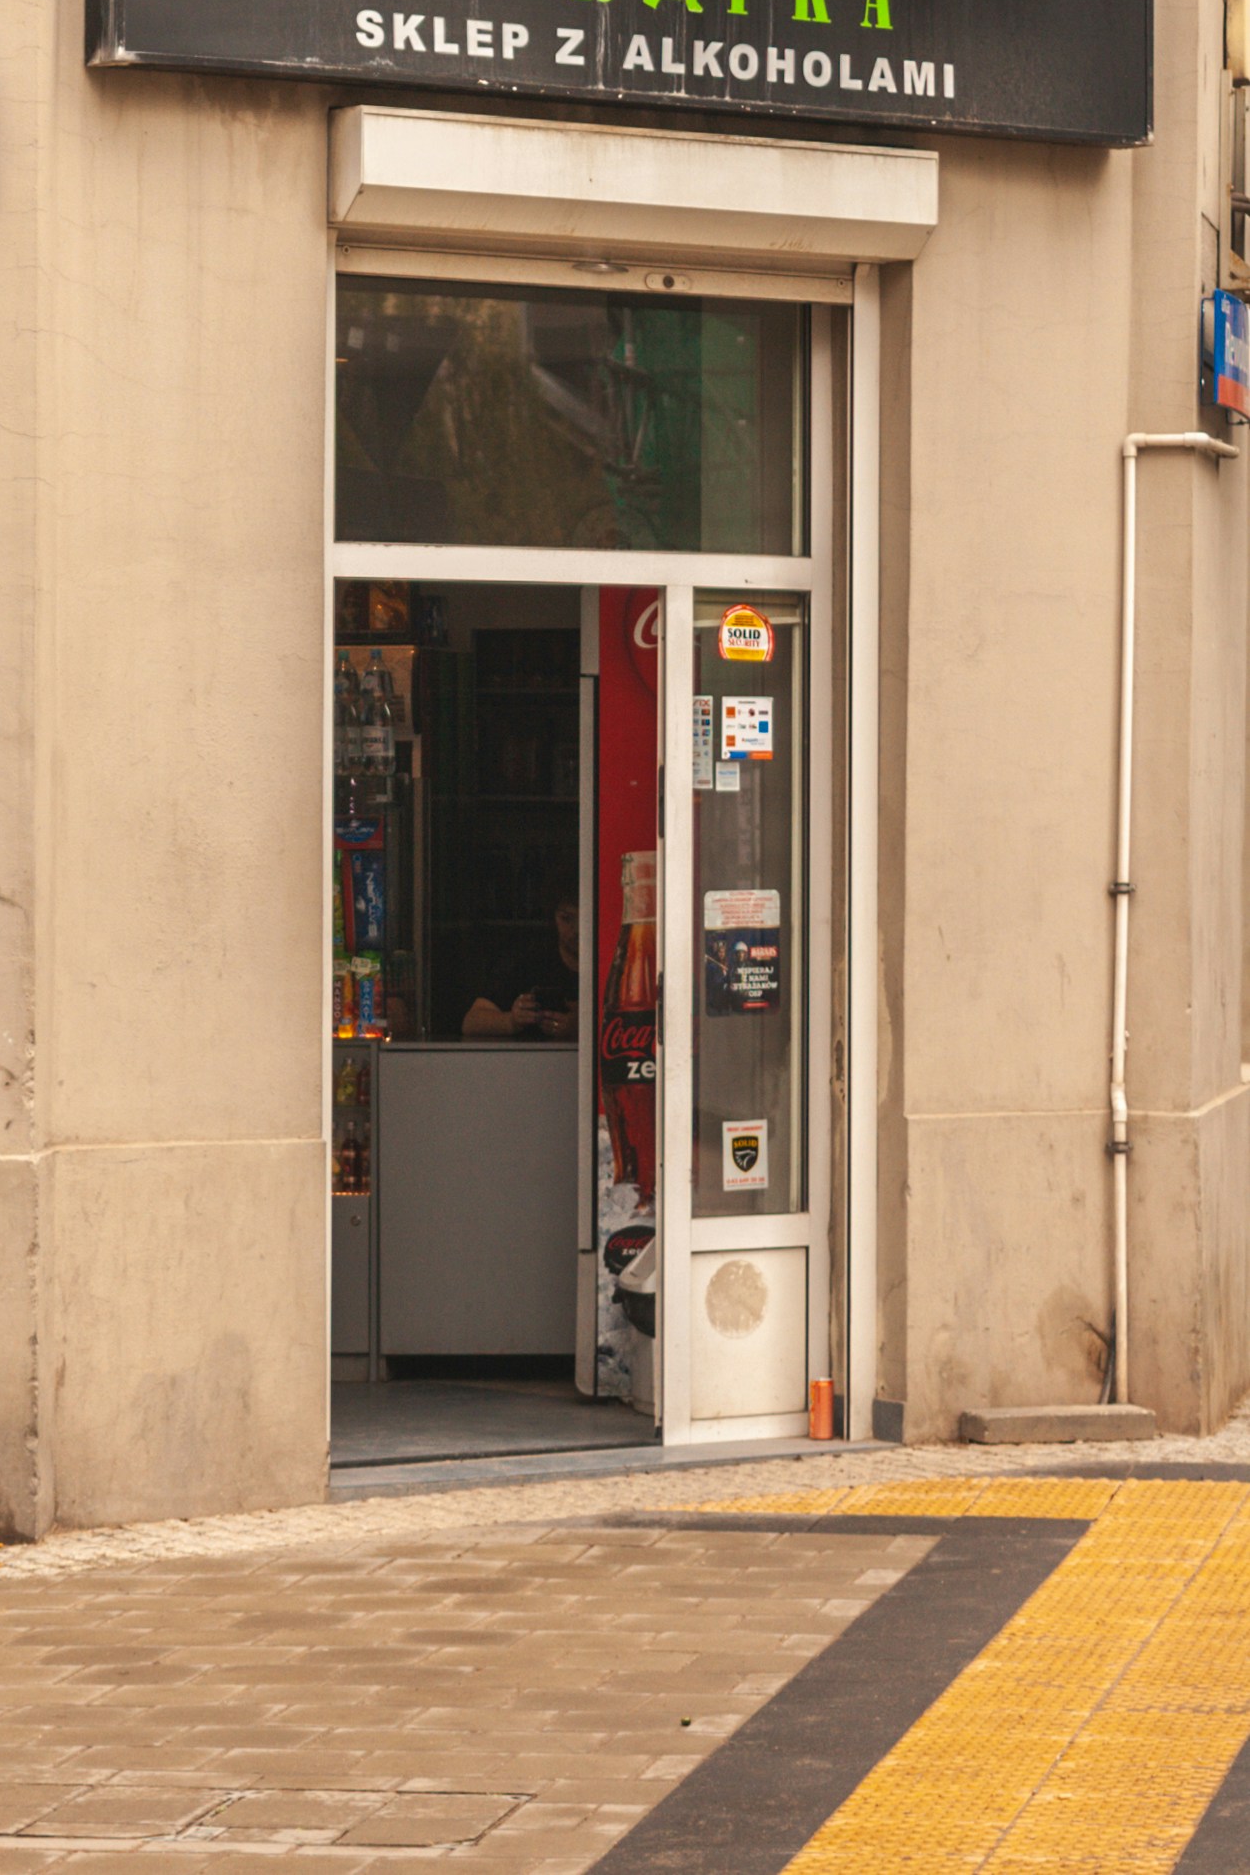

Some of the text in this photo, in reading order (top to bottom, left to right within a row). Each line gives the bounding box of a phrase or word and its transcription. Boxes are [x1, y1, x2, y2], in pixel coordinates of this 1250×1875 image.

[355, 9, 956, 100] SKLEP Z ALKOHOLAMI
[727, 627, 761, 639] SOLID
[627, 1061, 656, 1079] ze
[733, 1138, 758, 1149] SOLID
